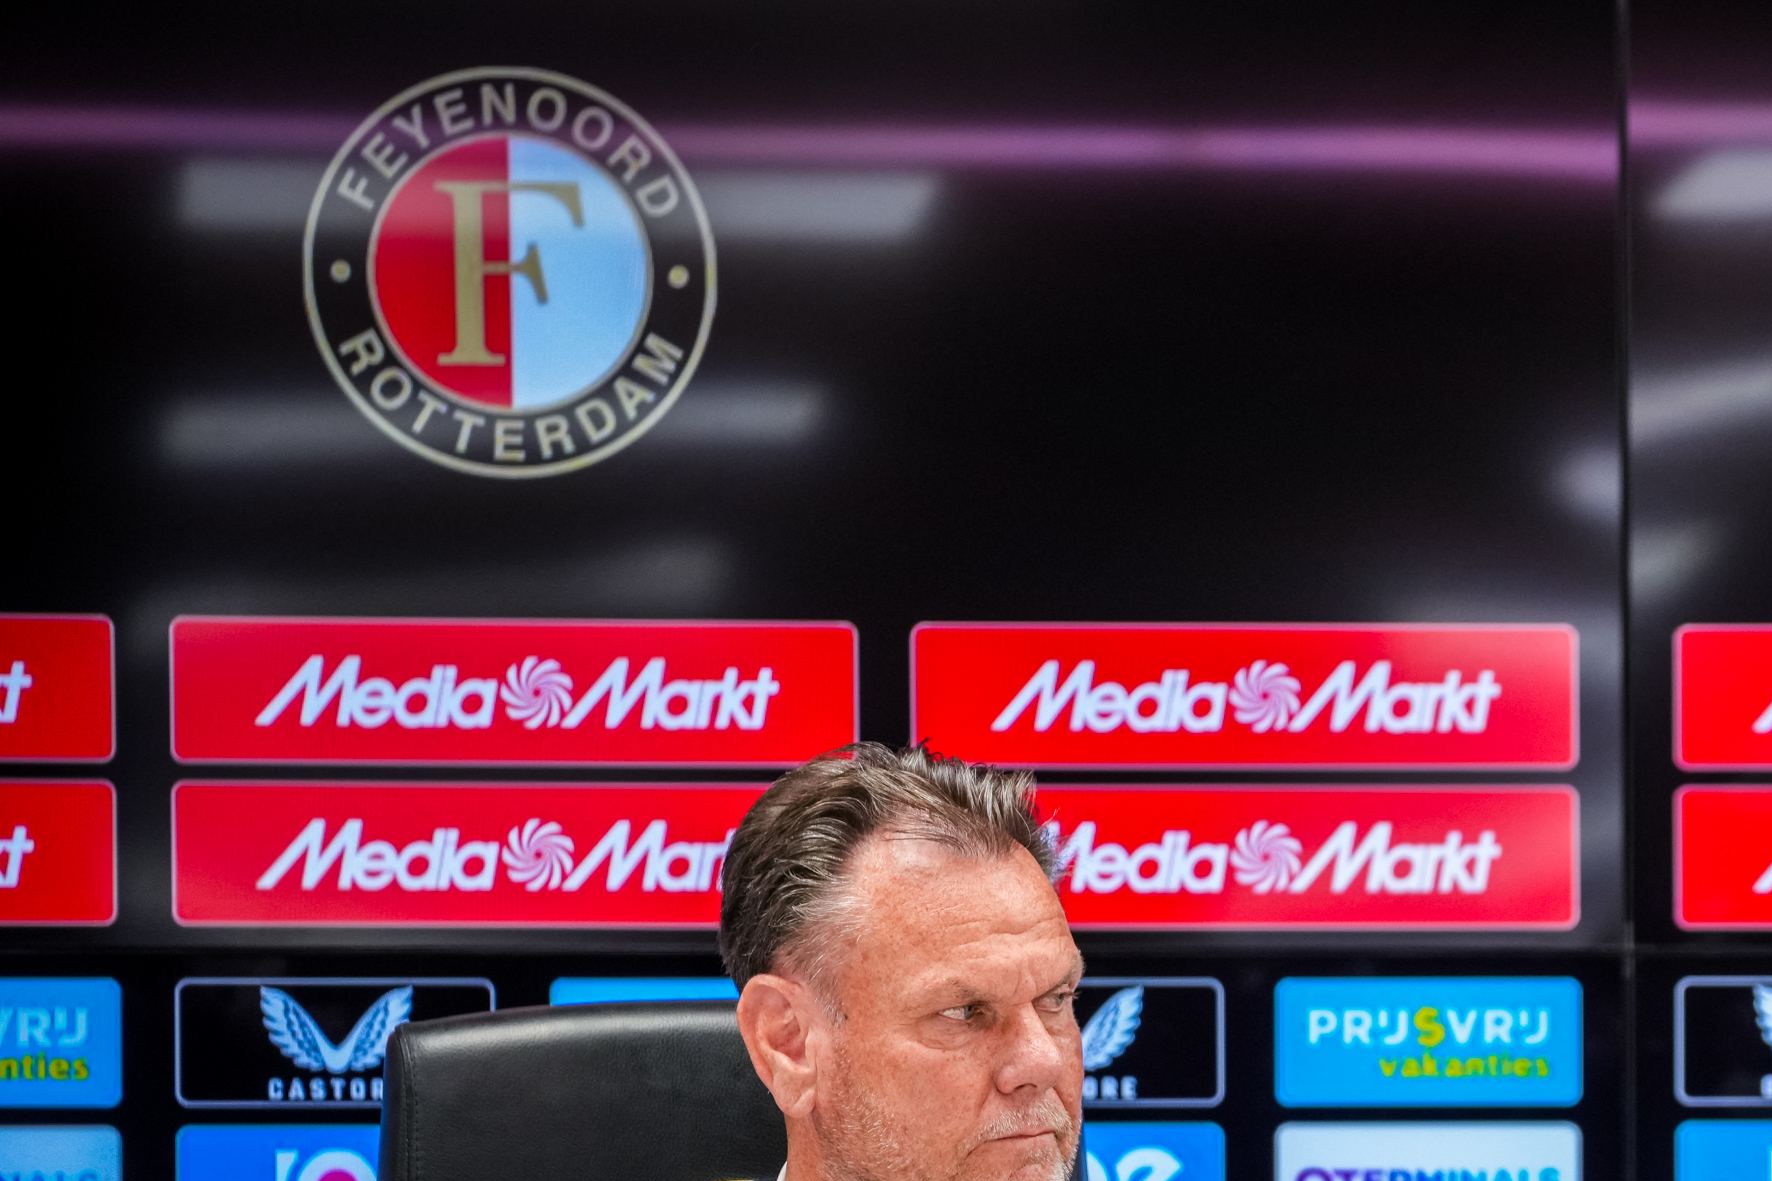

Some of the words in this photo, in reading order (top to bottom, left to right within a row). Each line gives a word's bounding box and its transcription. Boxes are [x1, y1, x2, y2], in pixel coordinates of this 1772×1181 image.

[336, 82, 680, 220] FEYENOORD
[433, 179, 585, 367] F
[338, 327, 685, 463] ROTTERDAM
[254, 654, 499, 729] Media
[560, 656, 781, 730] Markt
[991, 659, 1229, 734] Media
[1286, 659, 1502, 734] Markt
[255, 817, 500, 892] Media
[563, 818, 737, 892] Mar
[1286, 820, 1502, 895] Markt
[267, 1077, 384, 1101] CASTOR
